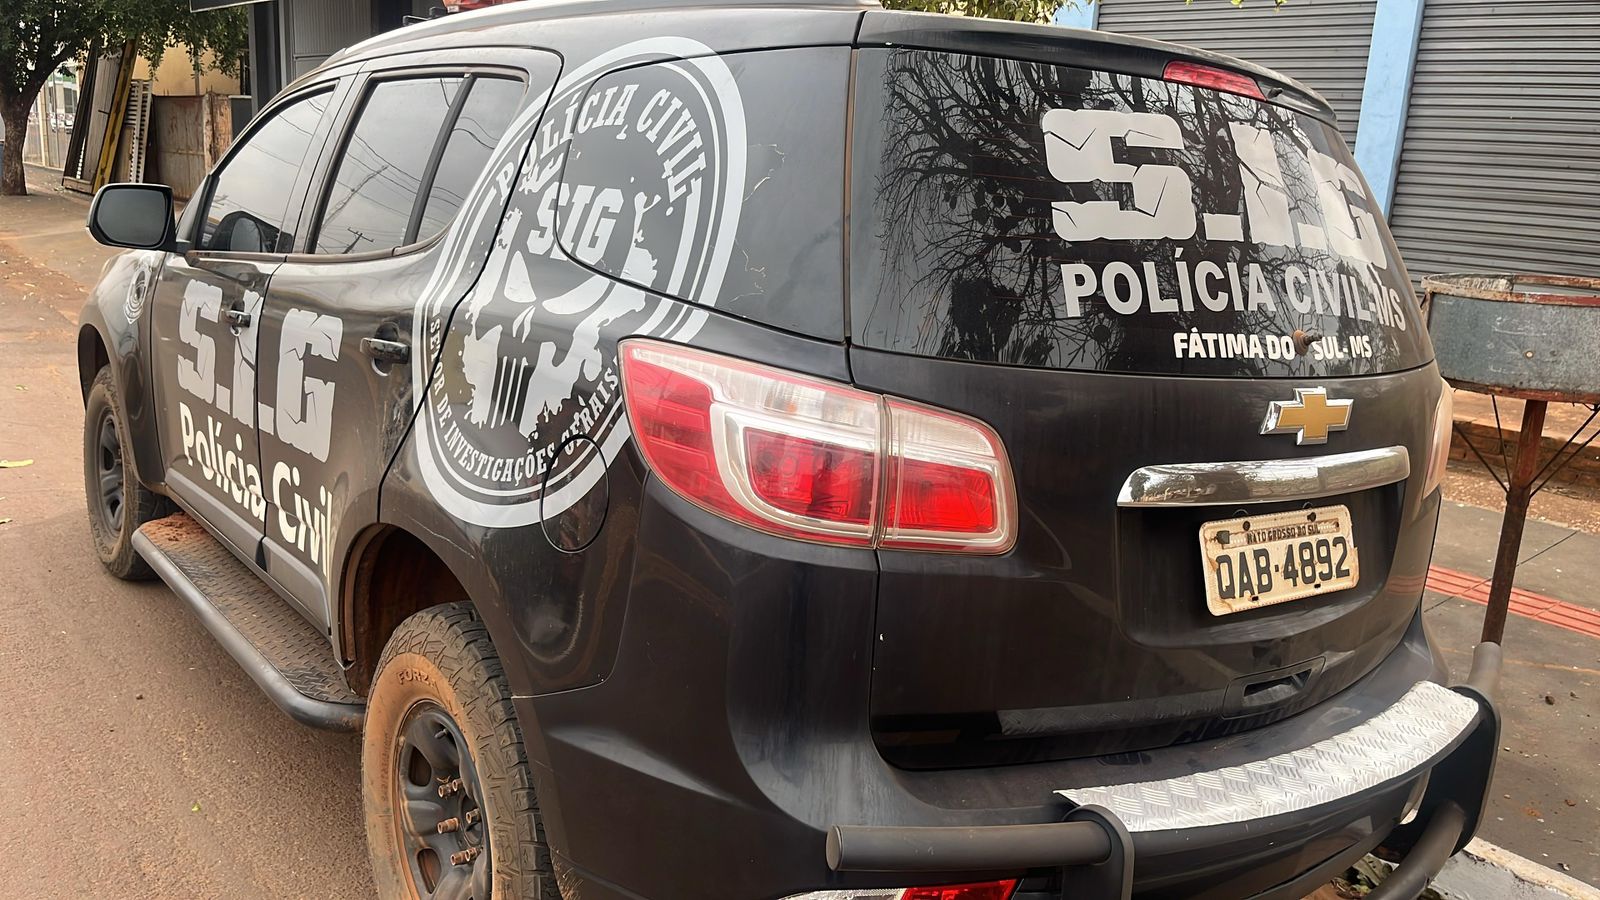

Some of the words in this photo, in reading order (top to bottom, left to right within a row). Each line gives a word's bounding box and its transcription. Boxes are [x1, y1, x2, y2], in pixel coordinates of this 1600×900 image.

[496, 84, 640, 206] POLÍCIA
[636, 88, 707, 203] CIVIL
[527, 182, 624, 265] SIG
[1061, 247, 1275, 317] POLÍCIA
[1266, 335, 1295, 360] DO
[1349, 335, 1373, 358] MS
[436, 393, 452, 428] DE
[443, 420, 559, 486] INVESTIGAÇÕES
[179, 402, 267, 522] Polícia
[272, 461, 333, 587] Civil
[1246, 531, 1267, 545] MATO
[1267, 527, 1296, 541] GROSSO
[1307, 523, 1321, 535] SUL
[1215, 536, 1350, 599] QAB-4892
